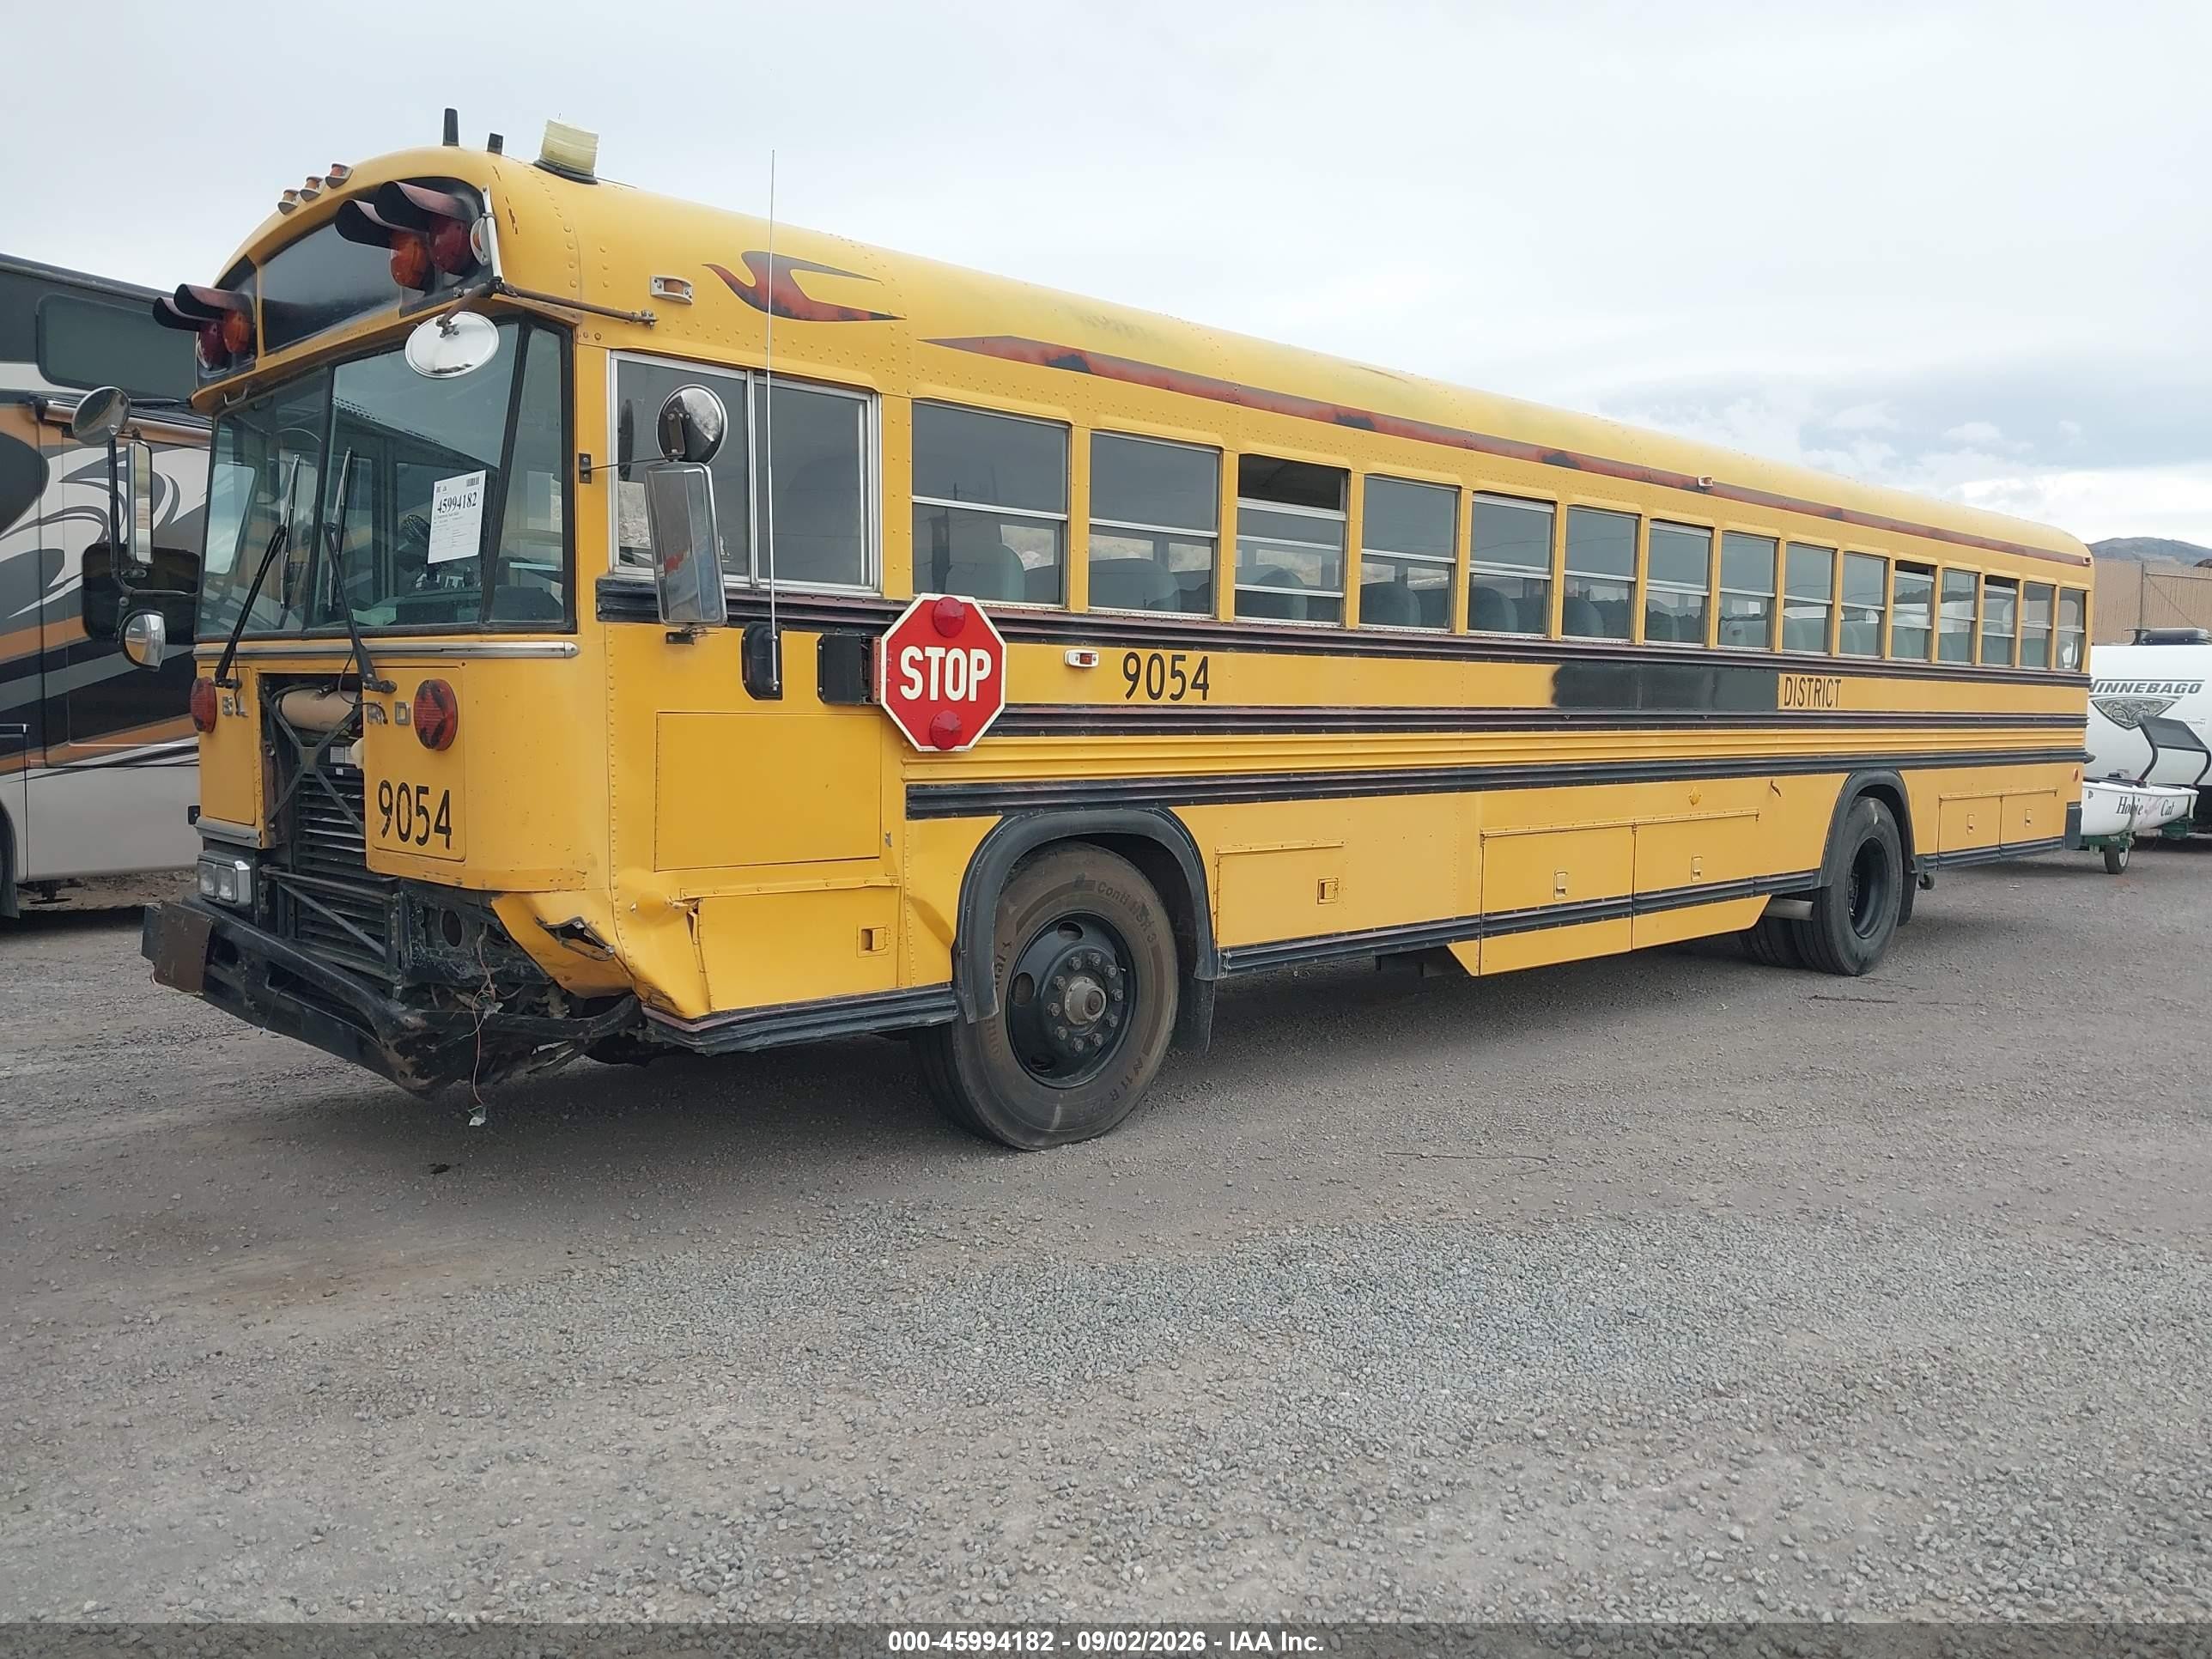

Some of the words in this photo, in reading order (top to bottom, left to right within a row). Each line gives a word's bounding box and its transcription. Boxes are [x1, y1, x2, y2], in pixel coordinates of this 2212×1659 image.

[437, 491, 477, 514] 45994182
[899, 646, 993, 702] STOP
[1122, 651, 1210, 702] 9054
[1784, 676, 1842, 708] DISTRICT
[378, 779, 453, 850] 9054
[2160, 799, 2175, 817] Cat
[1097, 880, 1131, 906] Conti
